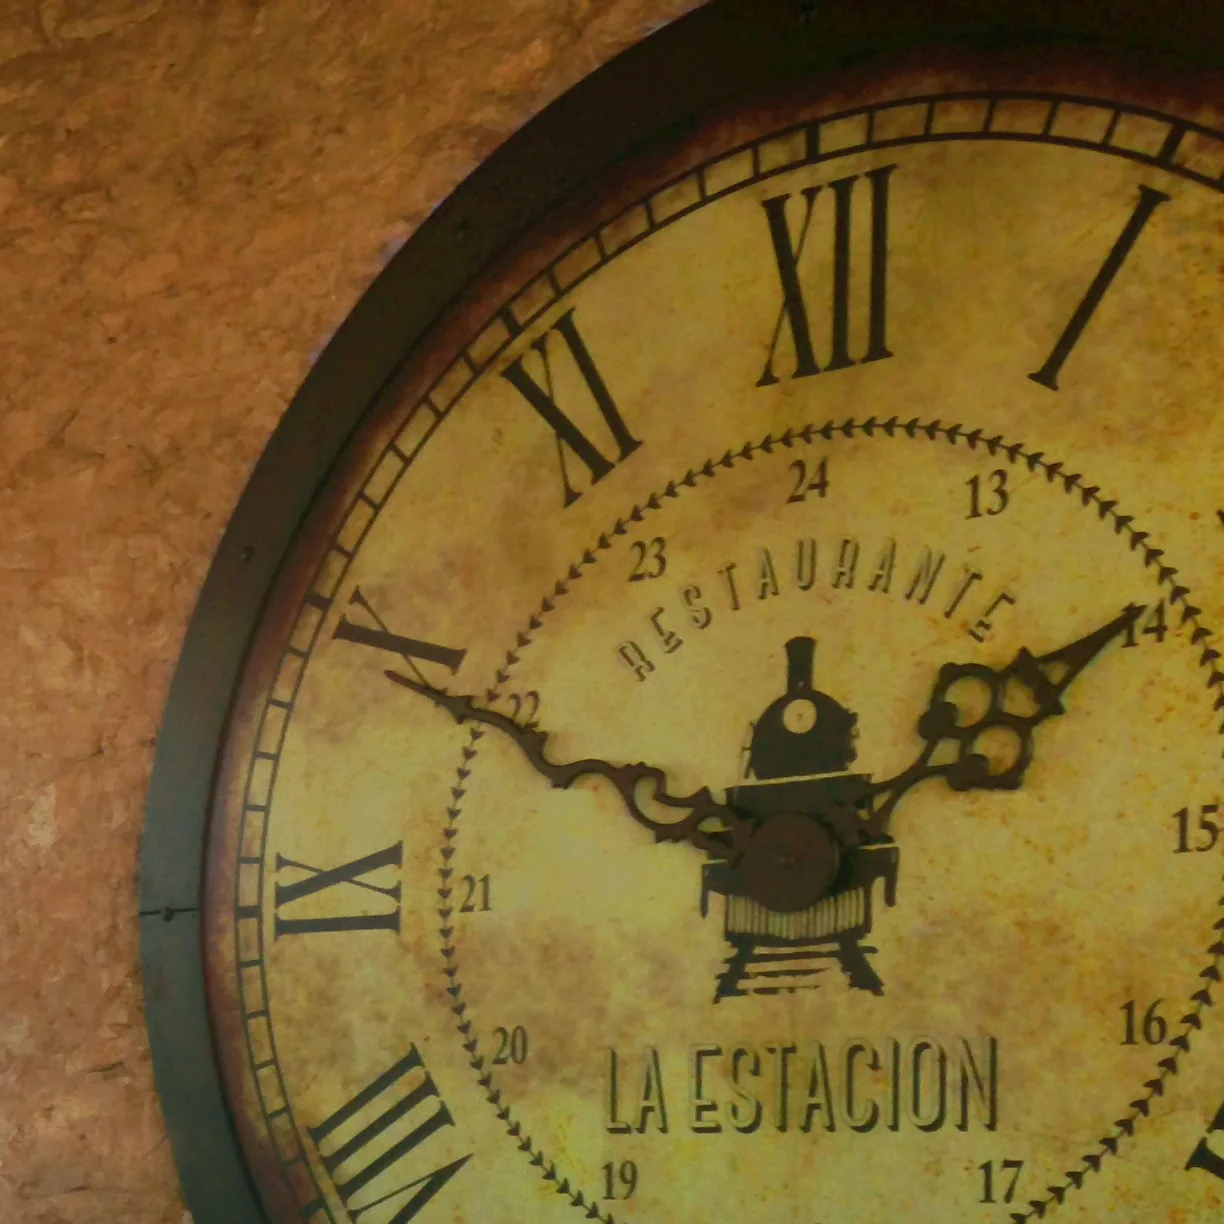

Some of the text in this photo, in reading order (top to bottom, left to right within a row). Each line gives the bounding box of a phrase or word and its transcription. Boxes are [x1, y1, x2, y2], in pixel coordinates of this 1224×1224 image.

[755, 163, 899, 388] XII
[501, 306, 644, 508] XI
[787, 456, 831, 505] 24
[964, 468, 1010, 520] 13
[627, 536, 668, 582] 23
[618, 537, 1017, 683] RESTAURANTE
[1120, 600, 1168, 648] 14
[1172, 804, 1218, 854] 15
[274, 840, 403, 943] IX
[459, 873, 493, 914] 21
[491, 1025, 528, 1066] 20
[1120, 999, 1167, 1046] 16
[604, 1036, 999, 1134] LA ESTACION
[601, 1160, 638, 1202] 19
[978, 1159, 1024, 1204] 17
